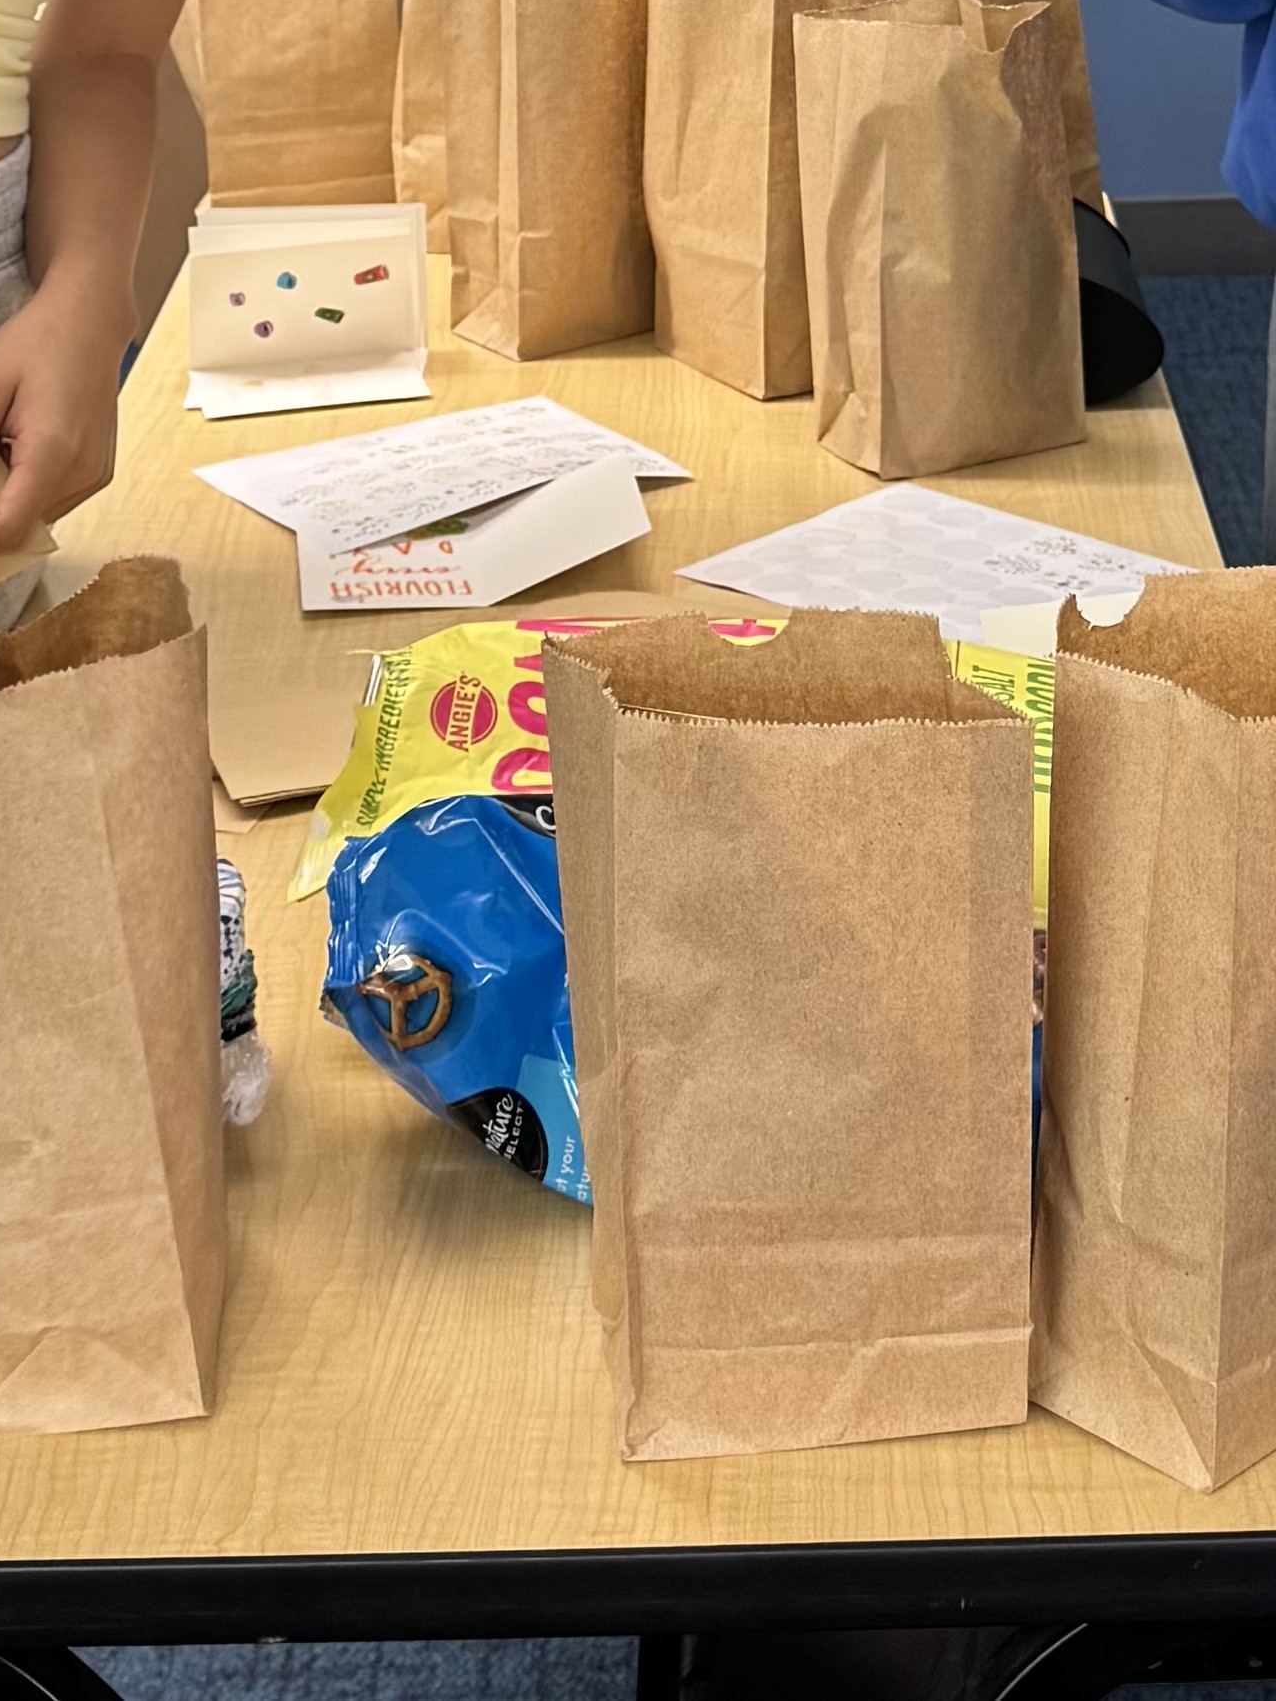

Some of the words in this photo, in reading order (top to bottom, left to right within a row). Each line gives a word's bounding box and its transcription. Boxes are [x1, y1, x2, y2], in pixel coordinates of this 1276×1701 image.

[330, 578, 474, 602] FLOURISH
[446, 673, 482, 753] ANGIE'S
[560, 1134, 577, 1175] your
